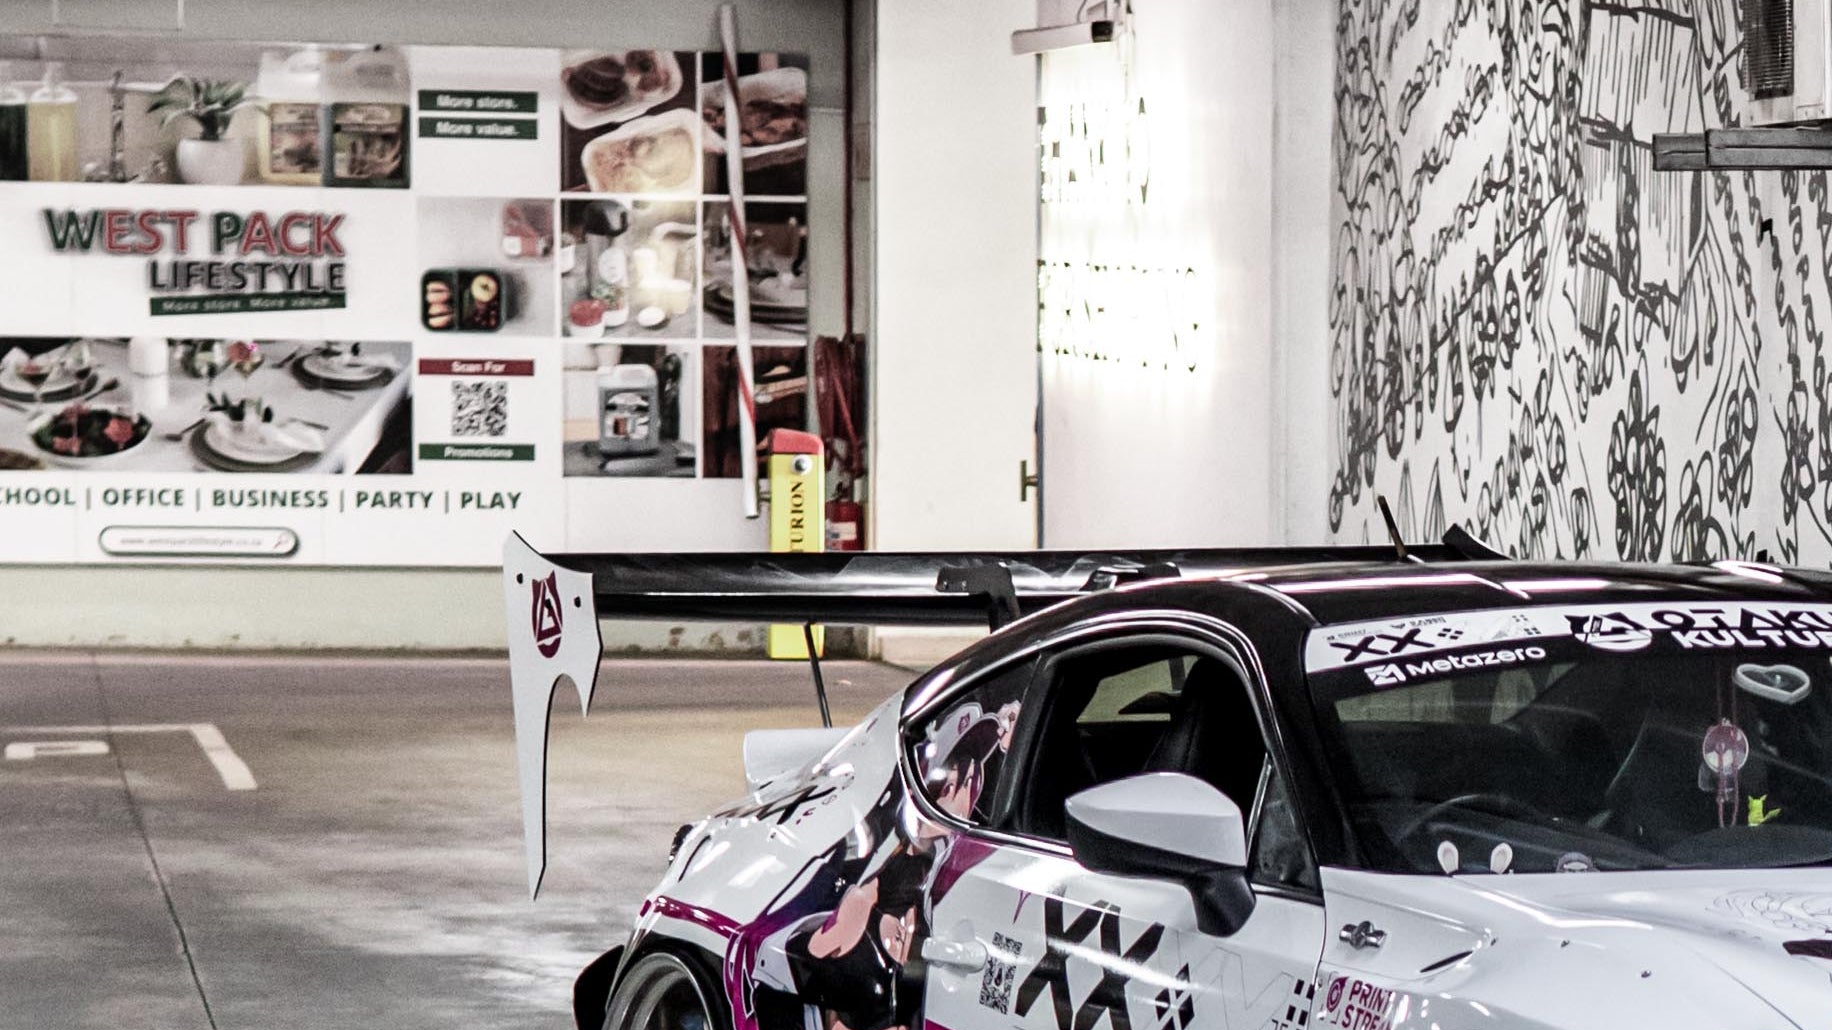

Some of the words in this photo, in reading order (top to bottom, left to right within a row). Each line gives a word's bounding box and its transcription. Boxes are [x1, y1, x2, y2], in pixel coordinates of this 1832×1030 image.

[44, 208, 197, 253] WEST
[214, 211, 346, 257] PACK
[149, 260, 346, 292] LIFESTYLE
[0, 487, 76, 506] HOOL
[102, 488, 185, 507] OFFICE
[212, 489, 329, 508] BUSINESS
[356, 490, 434, 509] PARTY
[460, 491, 522, 510] PLAY
[1405, 646, 1546, 677] Metazero
[1348, 979, 1395, 1015] PRINT
